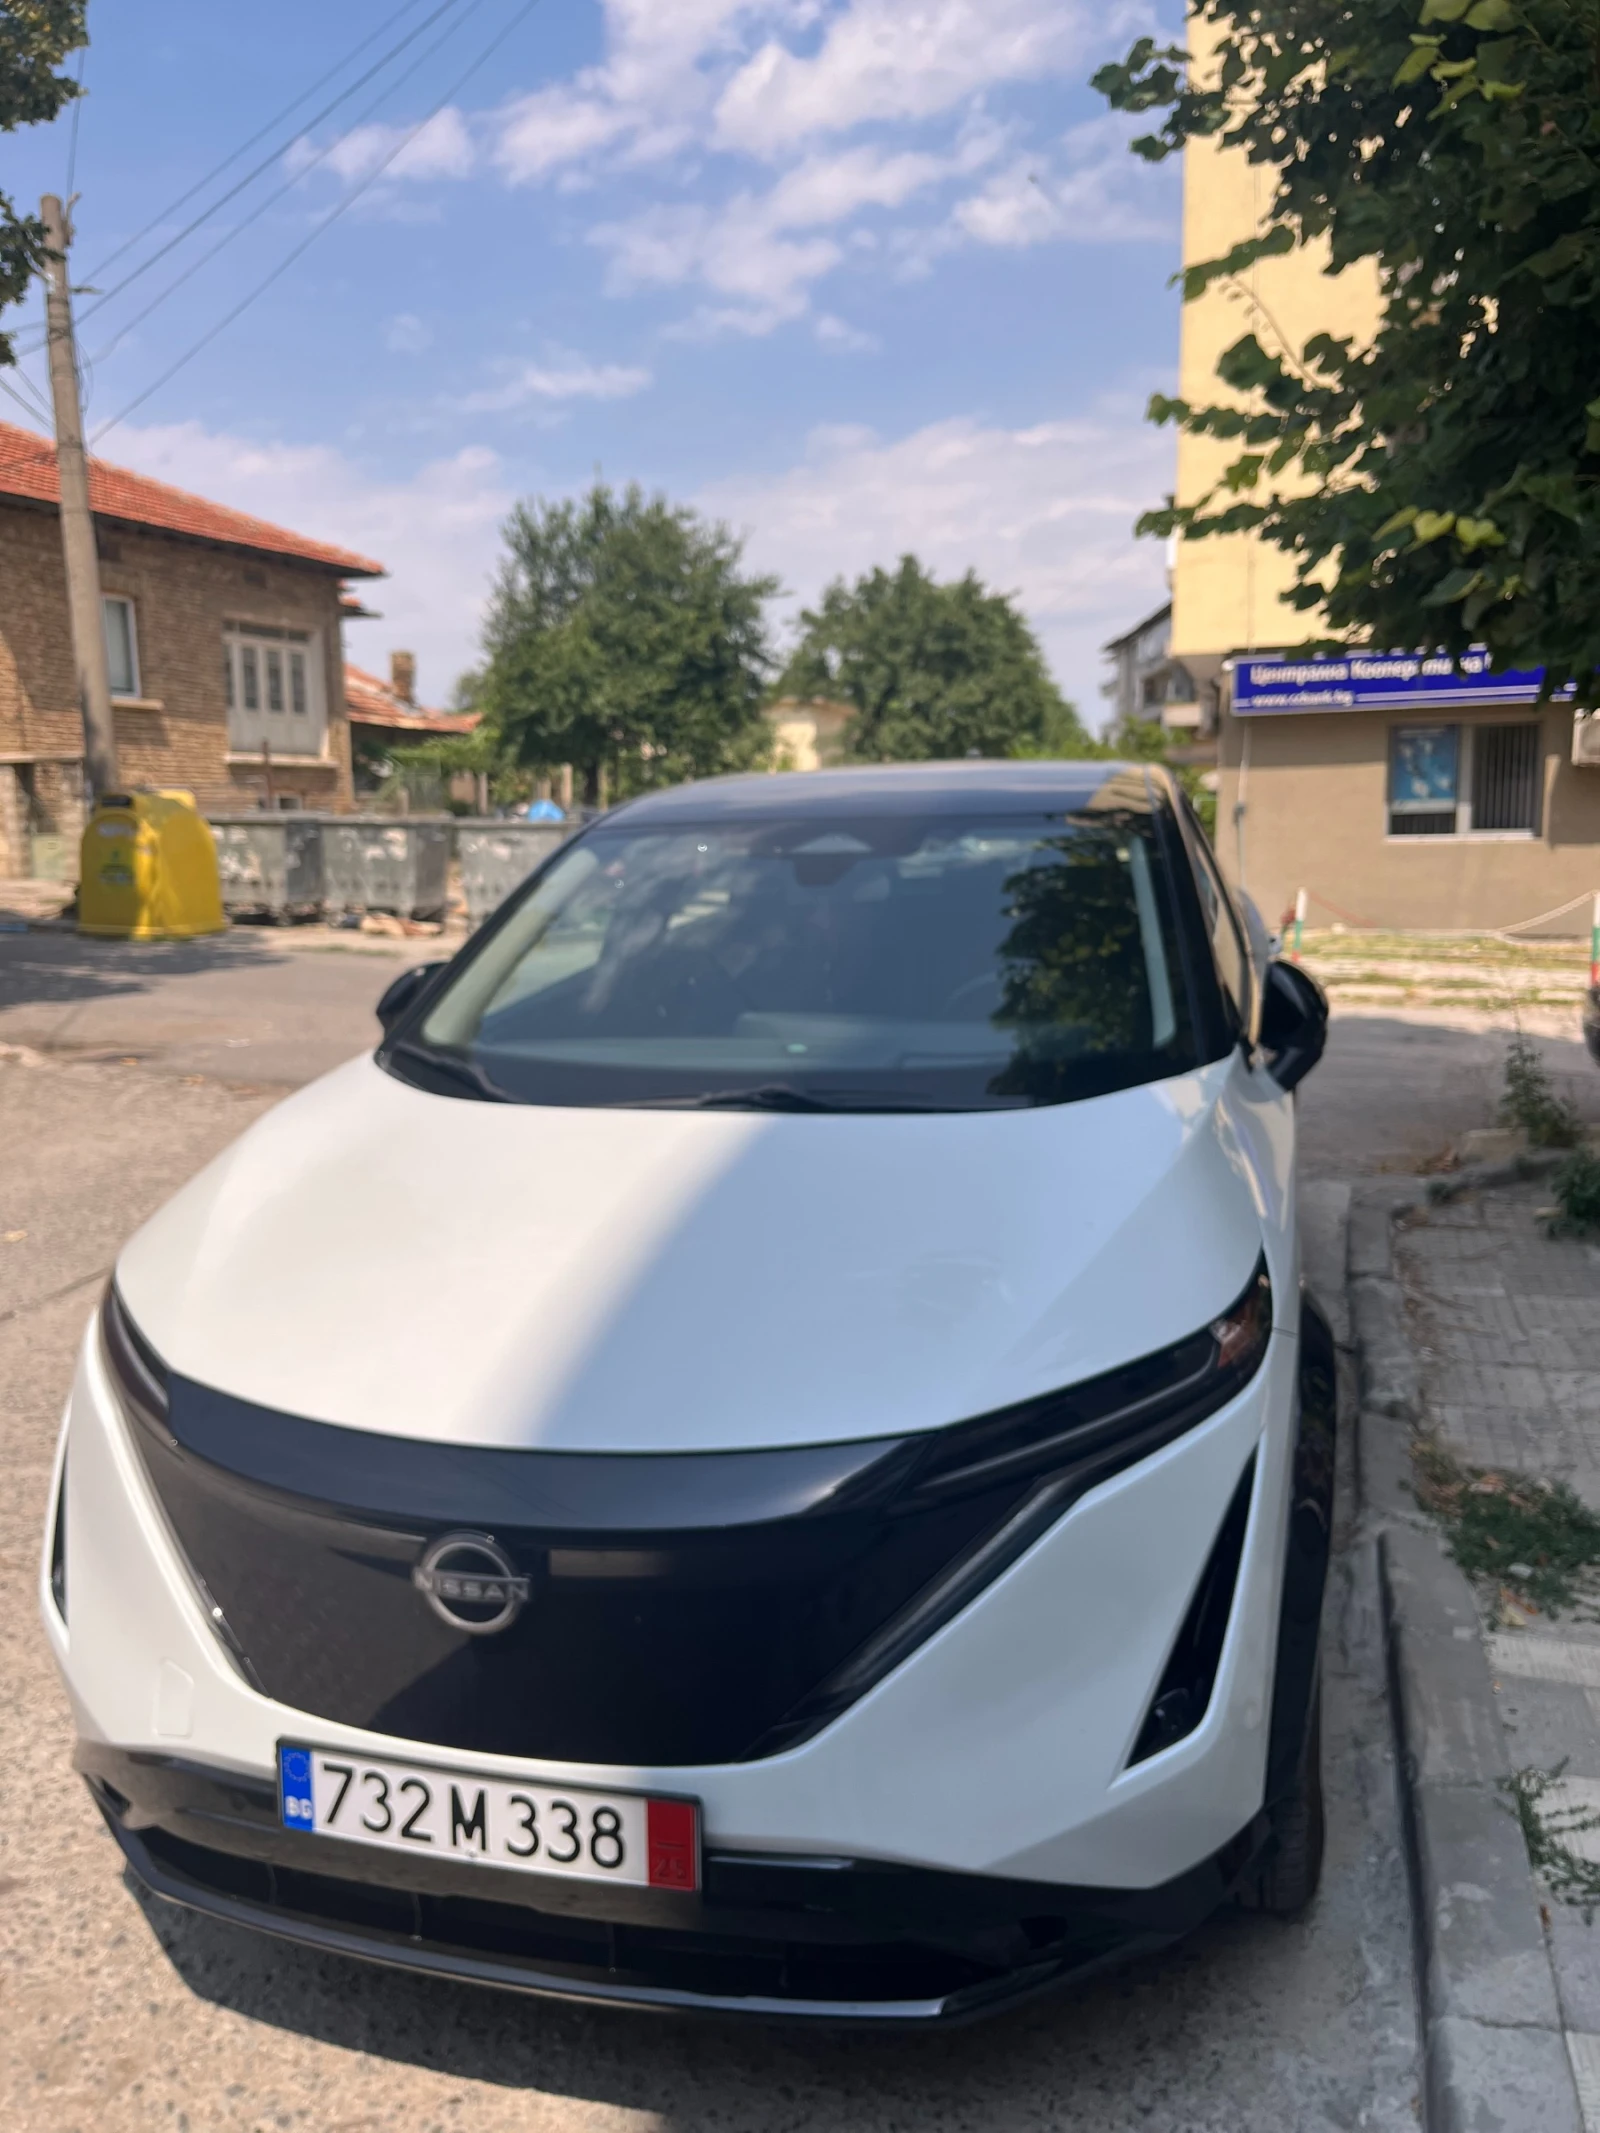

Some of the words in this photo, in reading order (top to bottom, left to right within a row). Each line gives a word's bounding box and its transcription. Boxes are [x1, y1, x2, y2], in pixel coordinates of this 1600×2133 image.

[414, 1567, 529, 1601] NISSAN
[286, 1796, 313, 1820] BG
[323, 1762, 432, 1842] 732
[452, 1785, 487, 1851] M
[507, 1794, 625, 1869] 338
